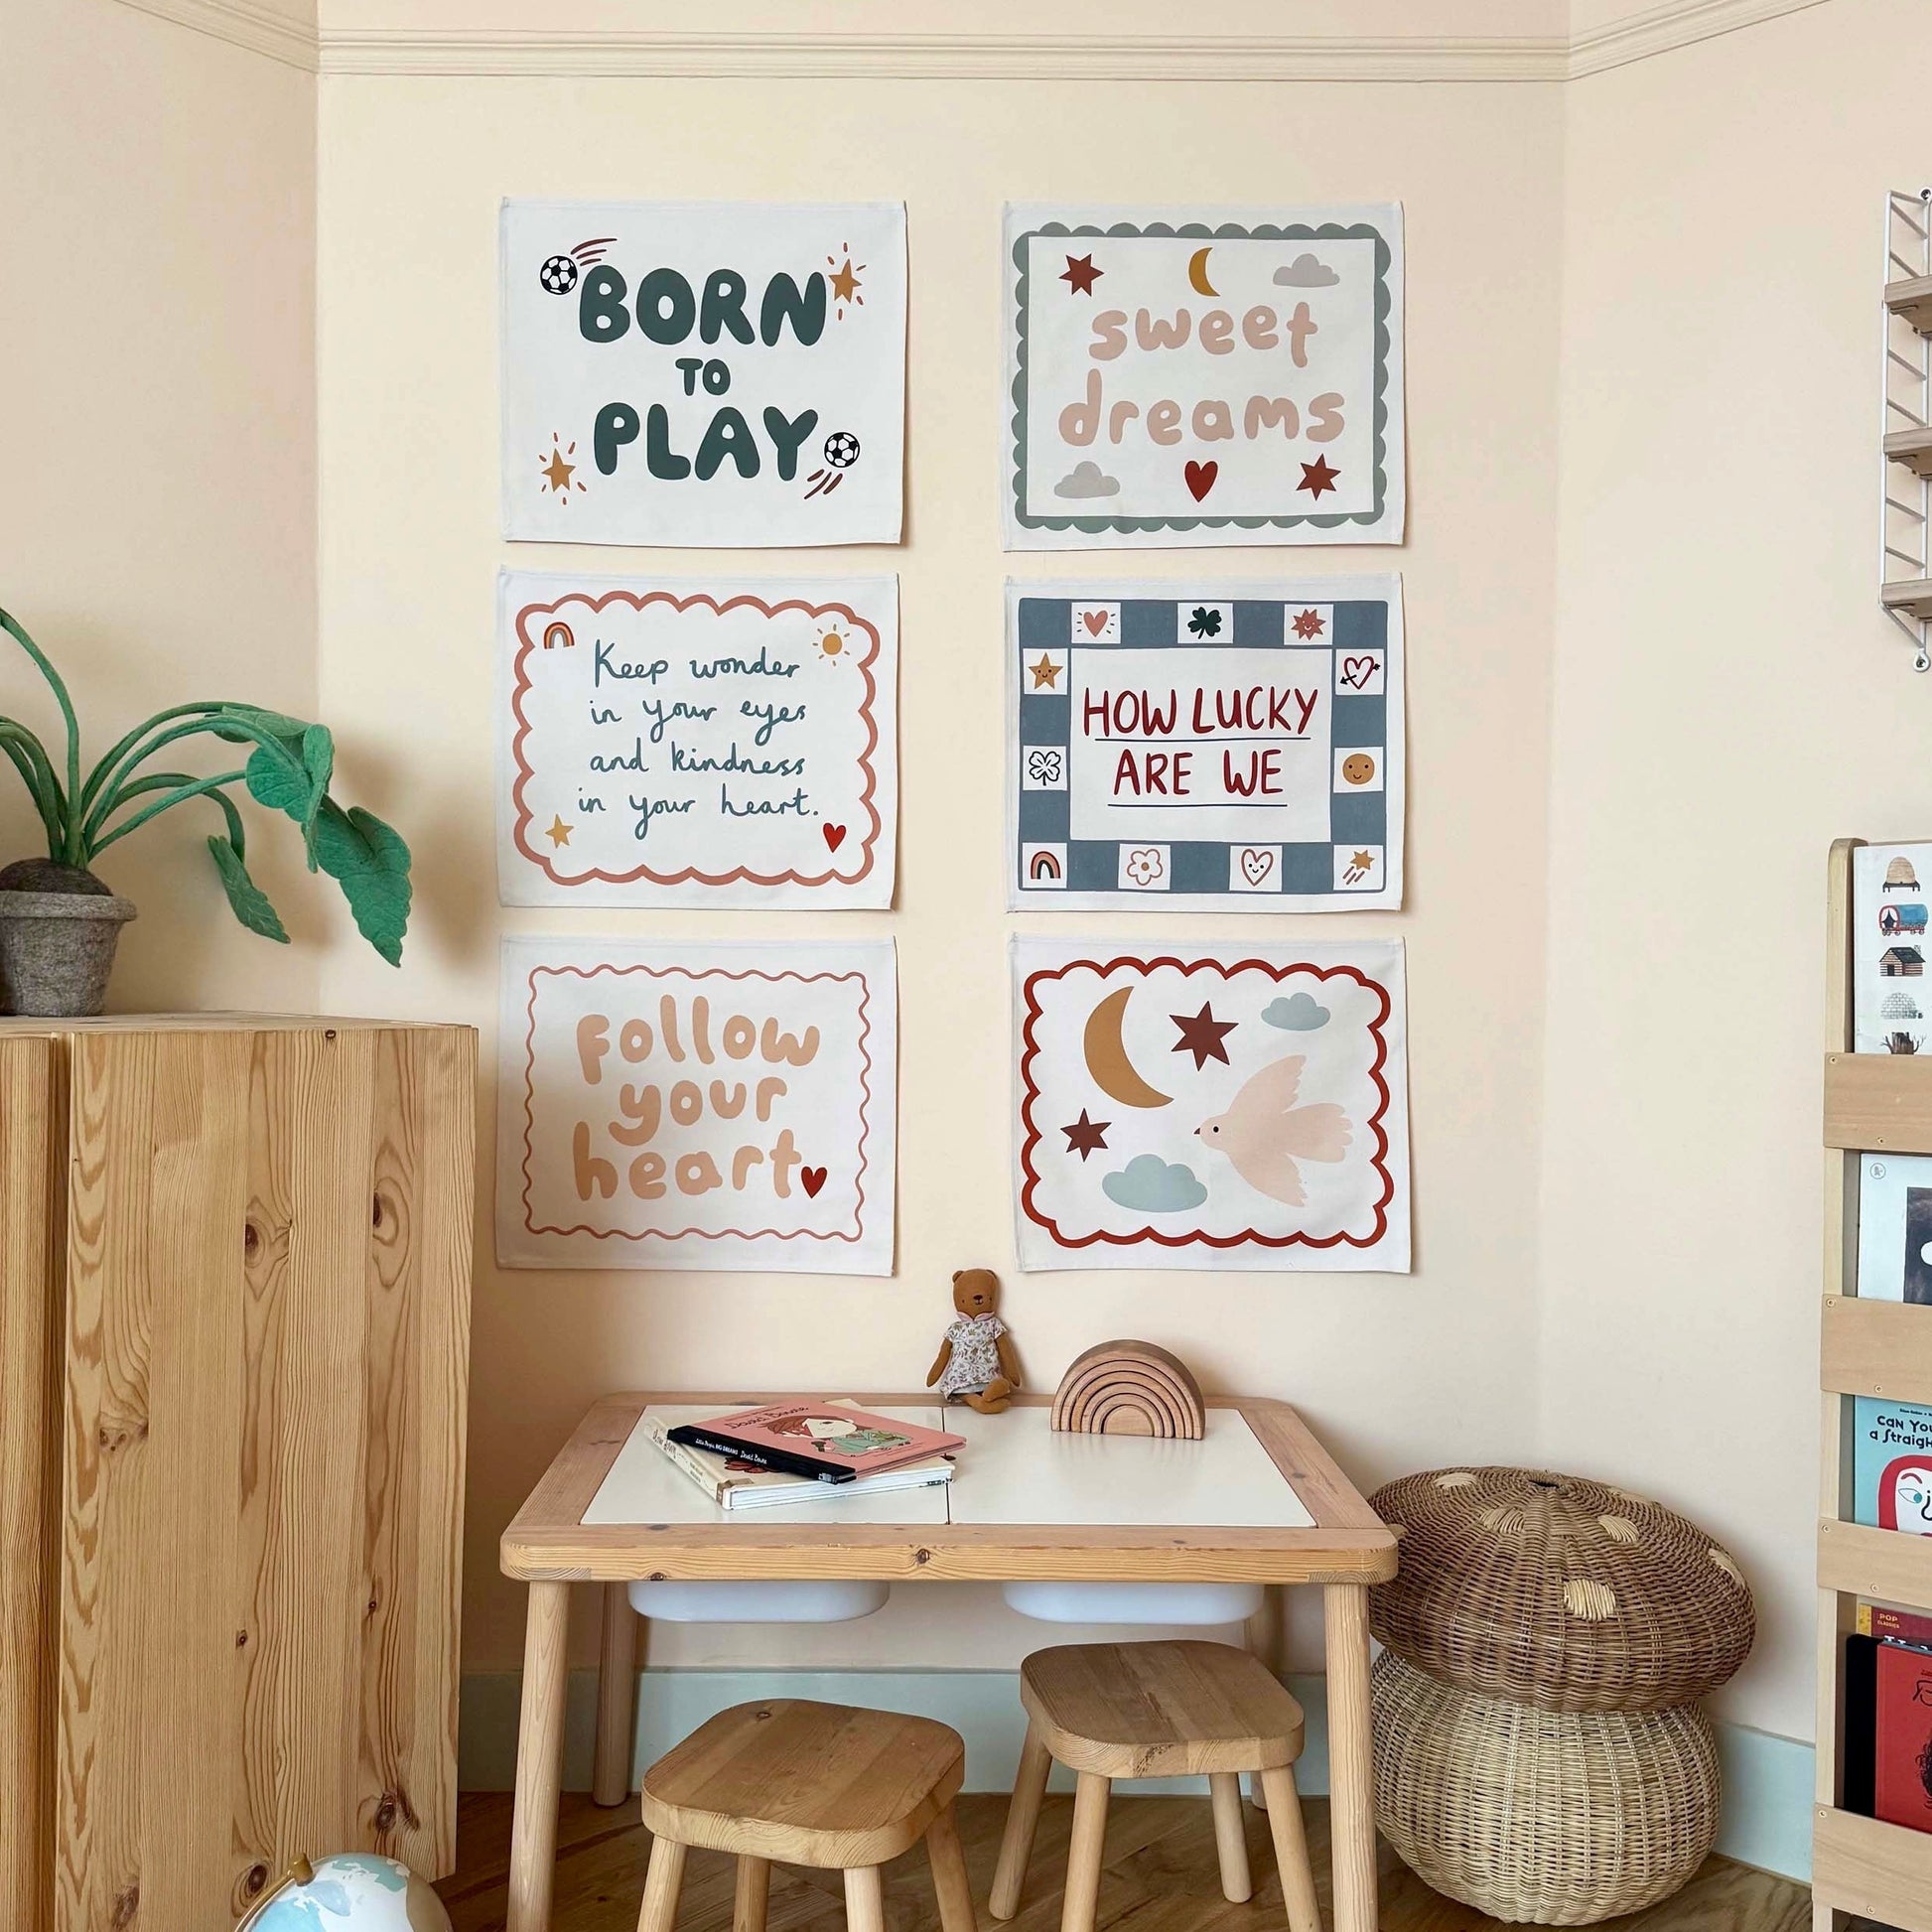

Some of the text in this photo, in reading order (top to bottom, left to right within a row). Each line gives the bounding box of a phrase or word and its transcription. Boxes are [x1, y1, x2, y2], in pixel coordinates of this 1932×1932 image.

[580, 265, 827, 346] BORN
[1089, 302, 1317, 367] sweet
[675, 358, 731, 396] TO
[1058, 368, 1345, 447] dreams
[594, 402, 818, 482] PLAY
[595, 639, 800, 688] Keep wonder
[590, 700, 806, 746] in your eyes
[1084, 686, 1318, 736] HOW LUCKY
[590, 737, 806, 776] and kindness
[1114, 749, 1284, 796] ARE WE
[579, 783, 818, 840] in your heart.
[576, 994, 820, 1085] follow
[608, 1077, 788, 1147] your
[572, 1121, 802, 1201] heart
[1869, 1431, 1878, 1441] a
[1879, 1612, 1898, 1622] POP
